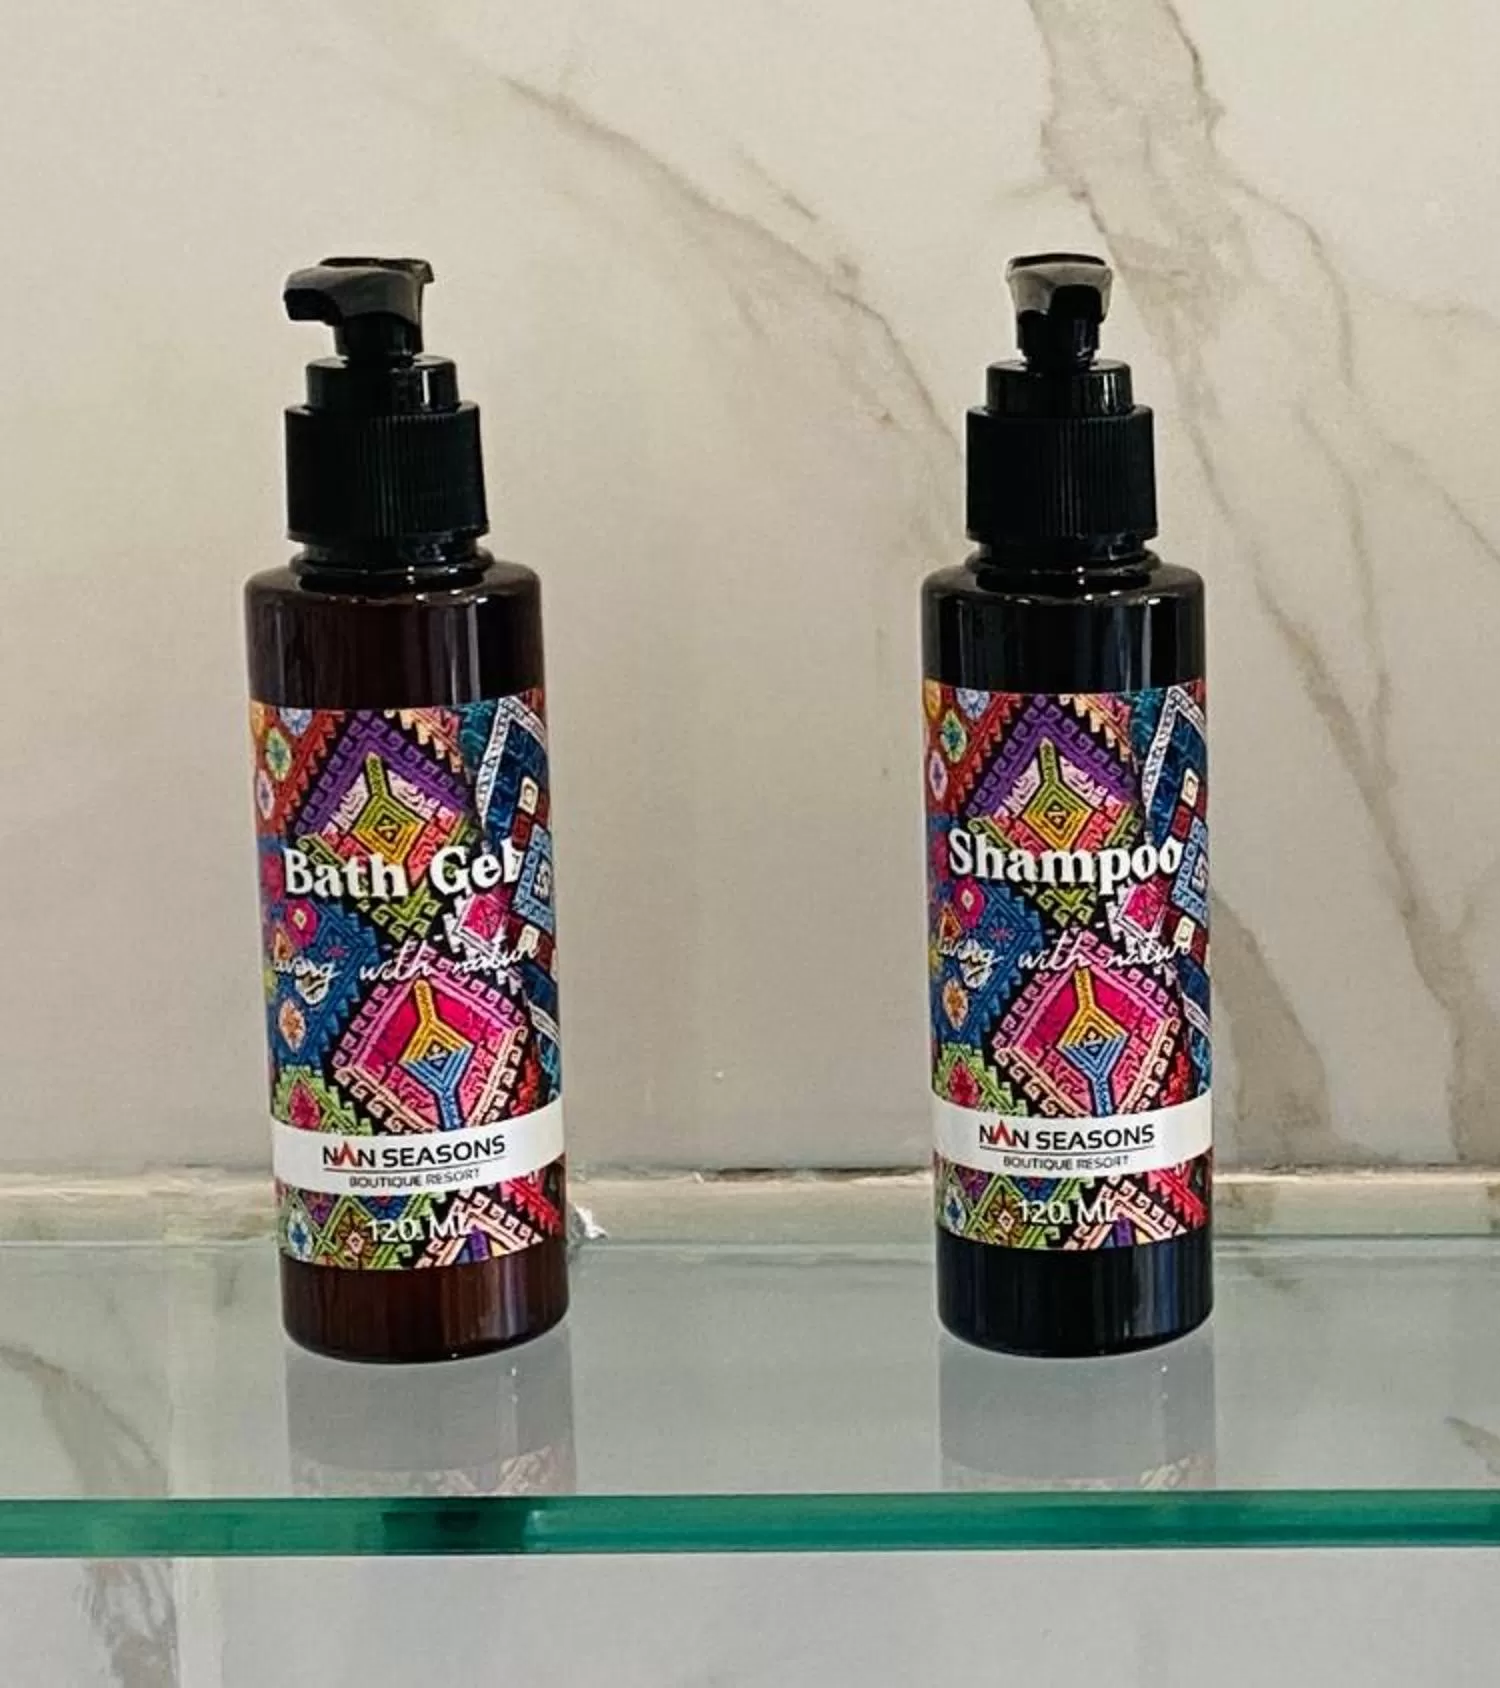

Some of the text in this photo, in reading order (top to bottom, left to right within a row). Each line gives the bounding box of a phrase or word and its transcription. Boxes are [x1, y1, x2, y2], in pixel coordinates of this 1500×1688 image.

[282, 837, 520, 898] Bath Gel
[949, 828, 1183, 895] Shampoo
[359, 938, 434, 982] with
[1018, 928, 1092, 971] with
[322, 1134, 506, 1167] NAN SEASONS
[979, 1120, 1155, 1150] NAN SEASONS
[1003, 1154, 1129, 1171] BOUTIQUE RESORT
[349, 1168, 480, 1189] BOUTIQUE RESORT
[1019, 1200, 1064, 1225] 120
[370, 1219, 416, 1242] 120
